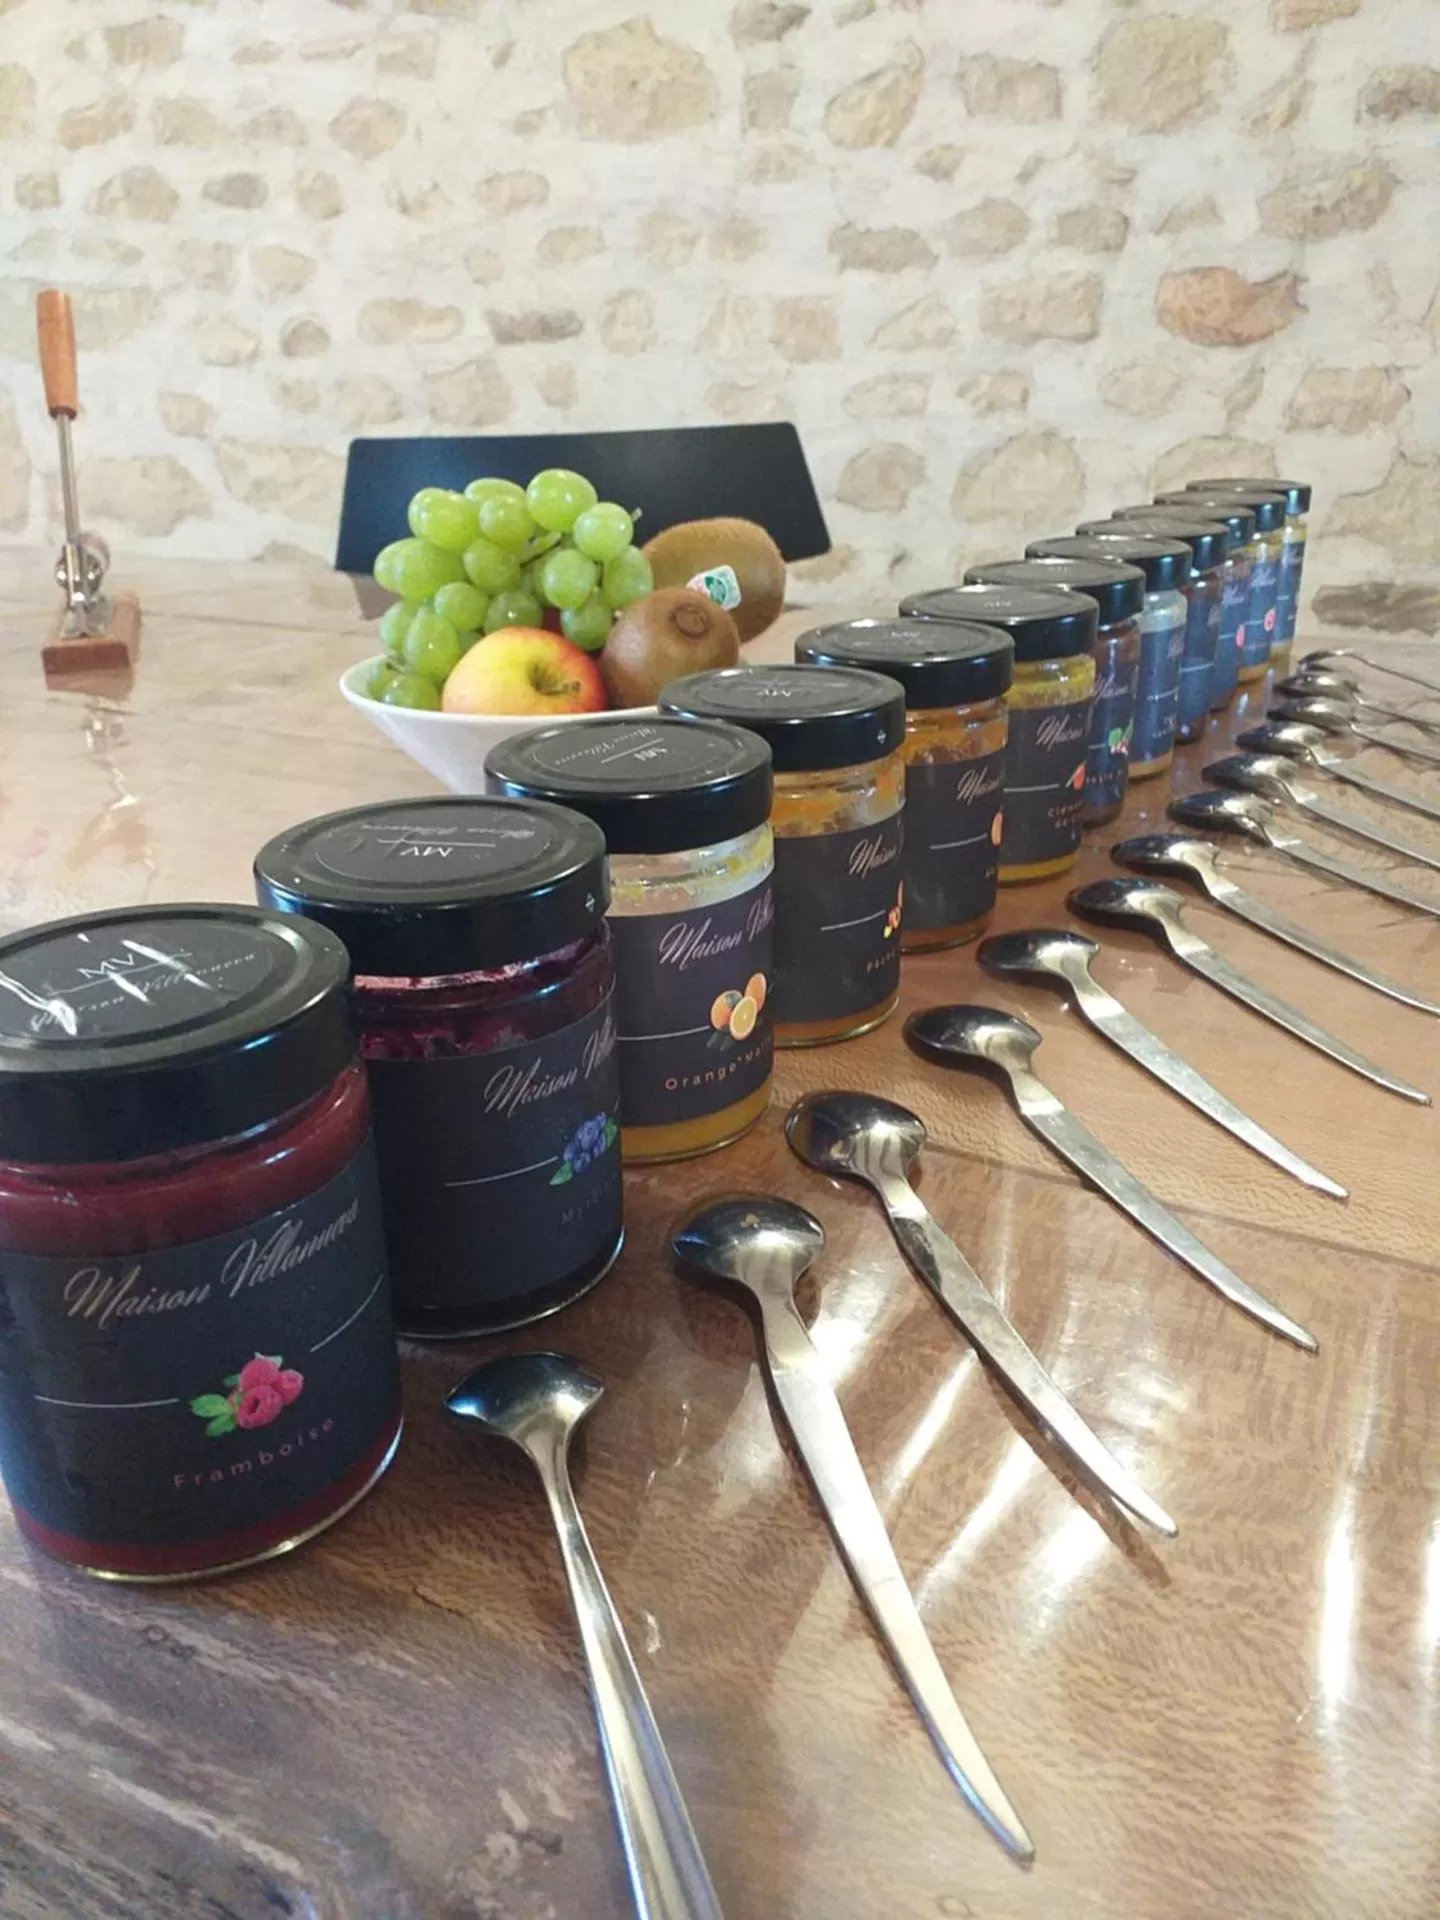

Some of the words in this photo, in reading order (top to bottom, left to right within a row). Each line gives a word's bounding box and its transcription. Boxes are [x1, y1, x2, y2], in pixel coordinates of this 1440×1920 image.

[400, 845, 453, 858] MV
[77, 953, 135, 980] MV
[659, 917, 743, 972] Maison
[484, 1056, 578, 1119] Maison
[64, 1265, 211, 1330] Maison
[173, 1417, 334, 1489] Framboise
